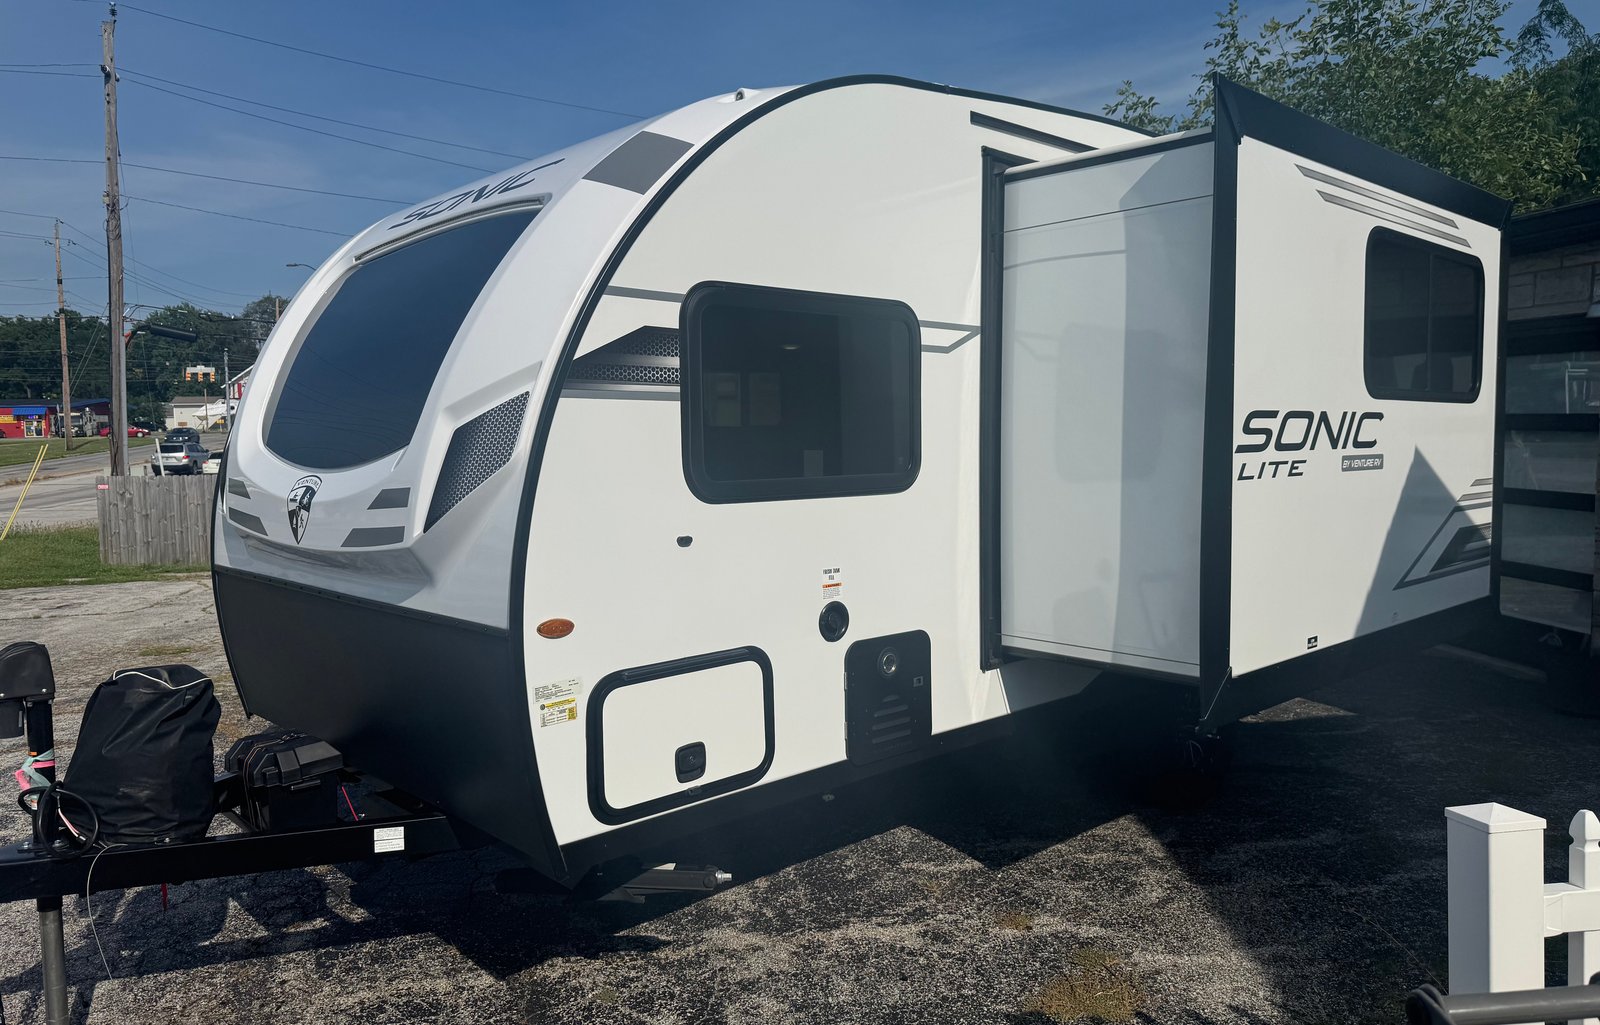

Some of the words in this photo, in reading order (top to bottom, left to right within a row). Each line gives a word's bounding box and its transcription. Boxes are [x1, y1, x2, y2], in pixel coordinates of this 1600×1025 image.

[387, 158, 565, 231] SONIC
[1234, 410, 1384, 453] SONIC
[1237, 460, 1307, 481] LITE
[1343, 460, 1351, 468] BY
[1351, 459, 1374, 468] VENTURE
[1374, 458, 1382, 467] RV
